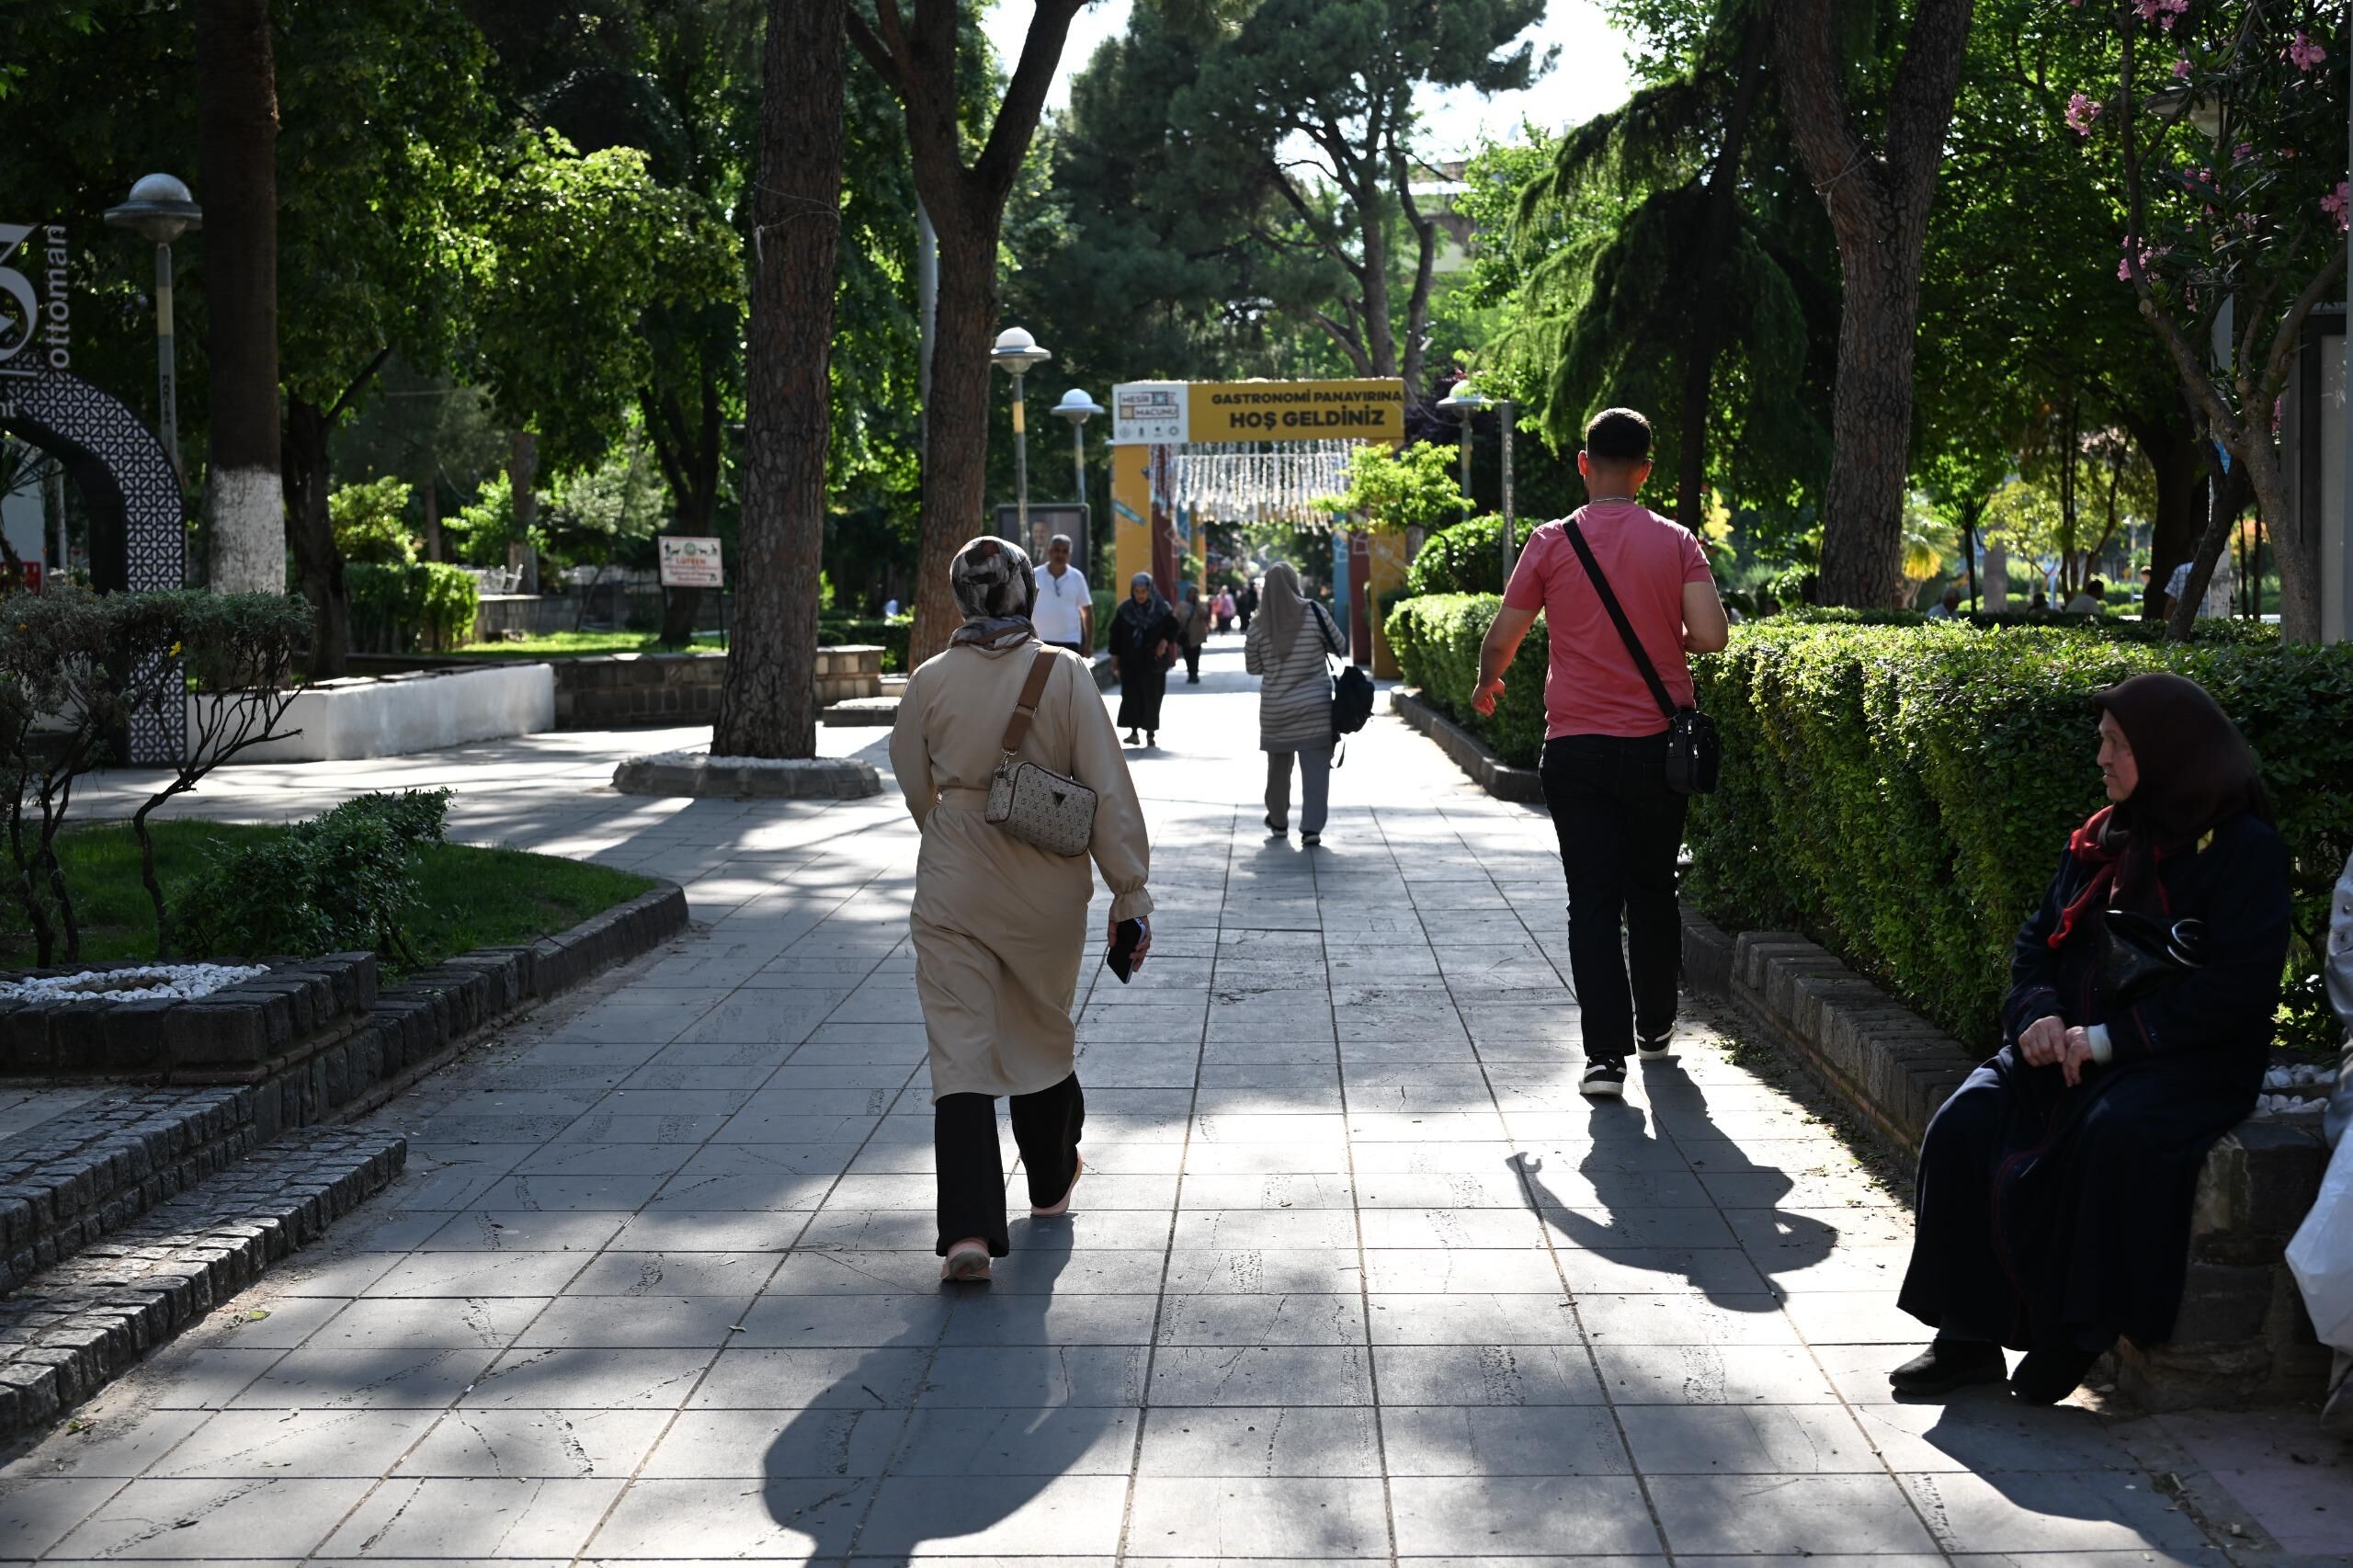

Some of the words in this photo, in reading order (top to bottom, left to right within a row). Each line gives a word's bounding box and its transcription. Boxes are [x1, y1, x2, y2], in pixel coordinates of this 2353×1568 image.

[46, 224, 71, 369] ottoman
[1212, 389, 1311, 404] GASTRONOMİ
[1313, 390, 1403, 403] PANAYIRINA
[1230, 411, 1278, 431] HOŞ
[1282, 404, 1385, 427] GELDİNİZ
